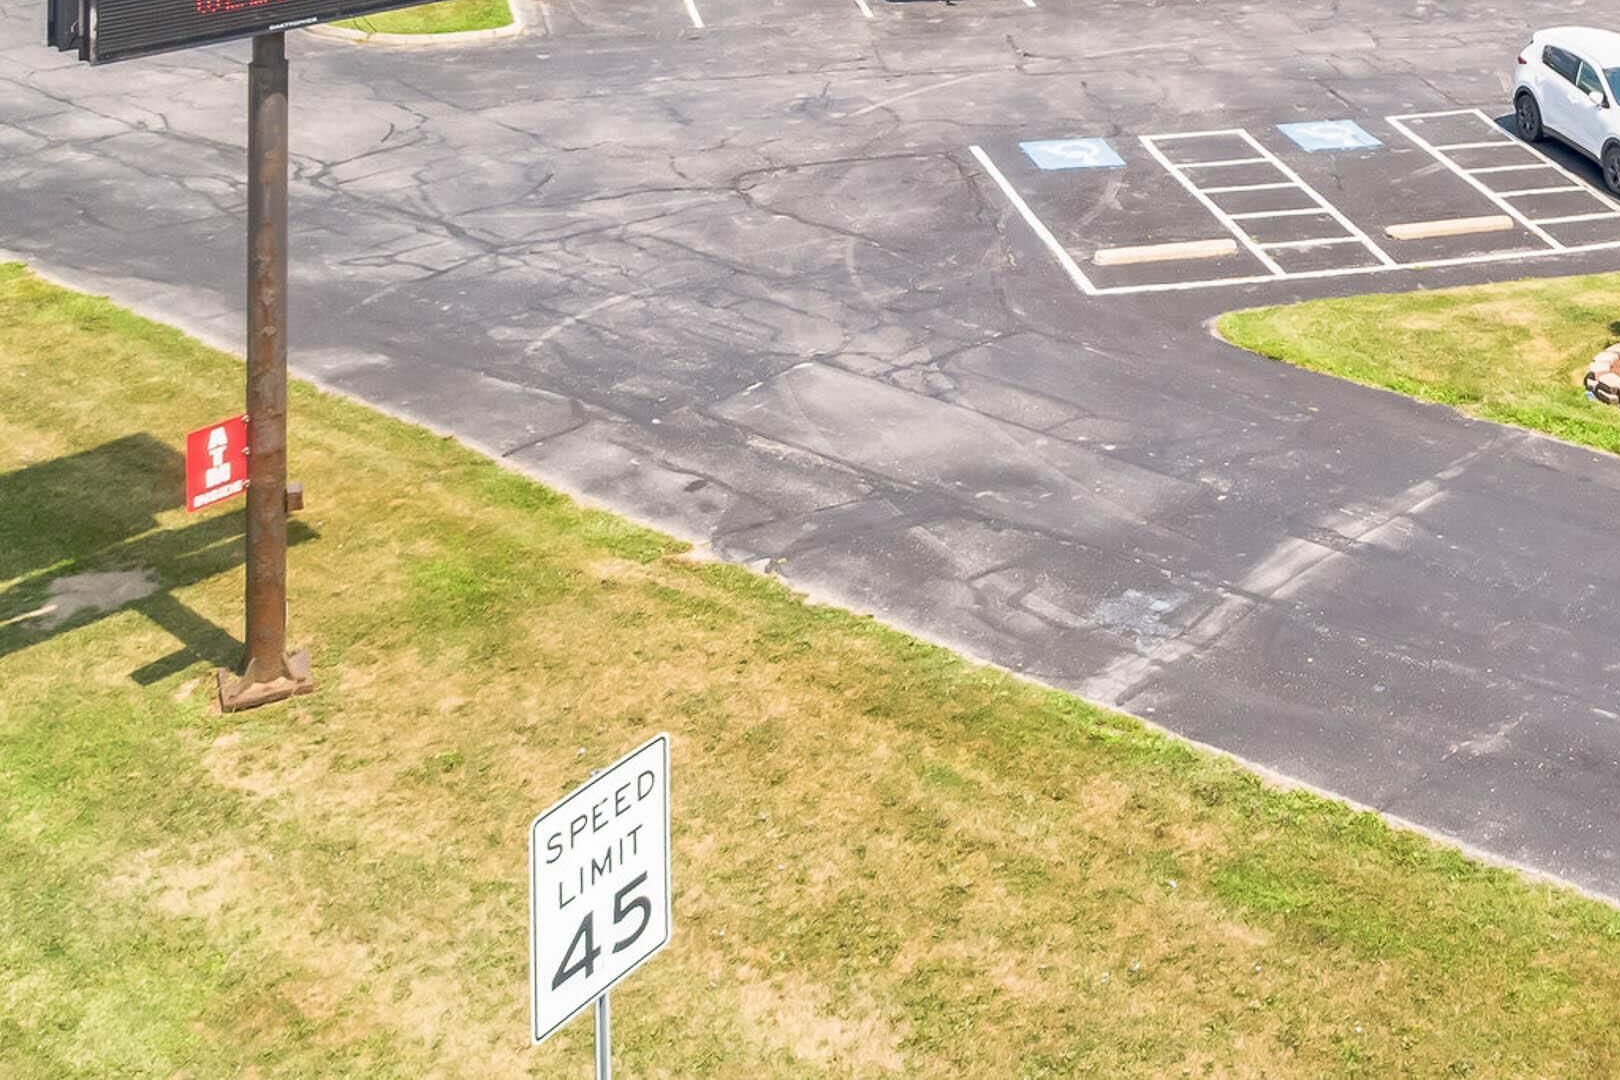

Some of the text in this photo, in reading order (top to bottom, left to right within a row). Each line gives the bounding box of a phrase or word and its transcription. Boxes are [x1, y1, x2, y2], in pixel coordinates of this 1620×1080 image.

[546, 770, 655, 864] SPEED
[559, 825, 643, 908] LIMIT
[552, 871, 652, 991] 45
